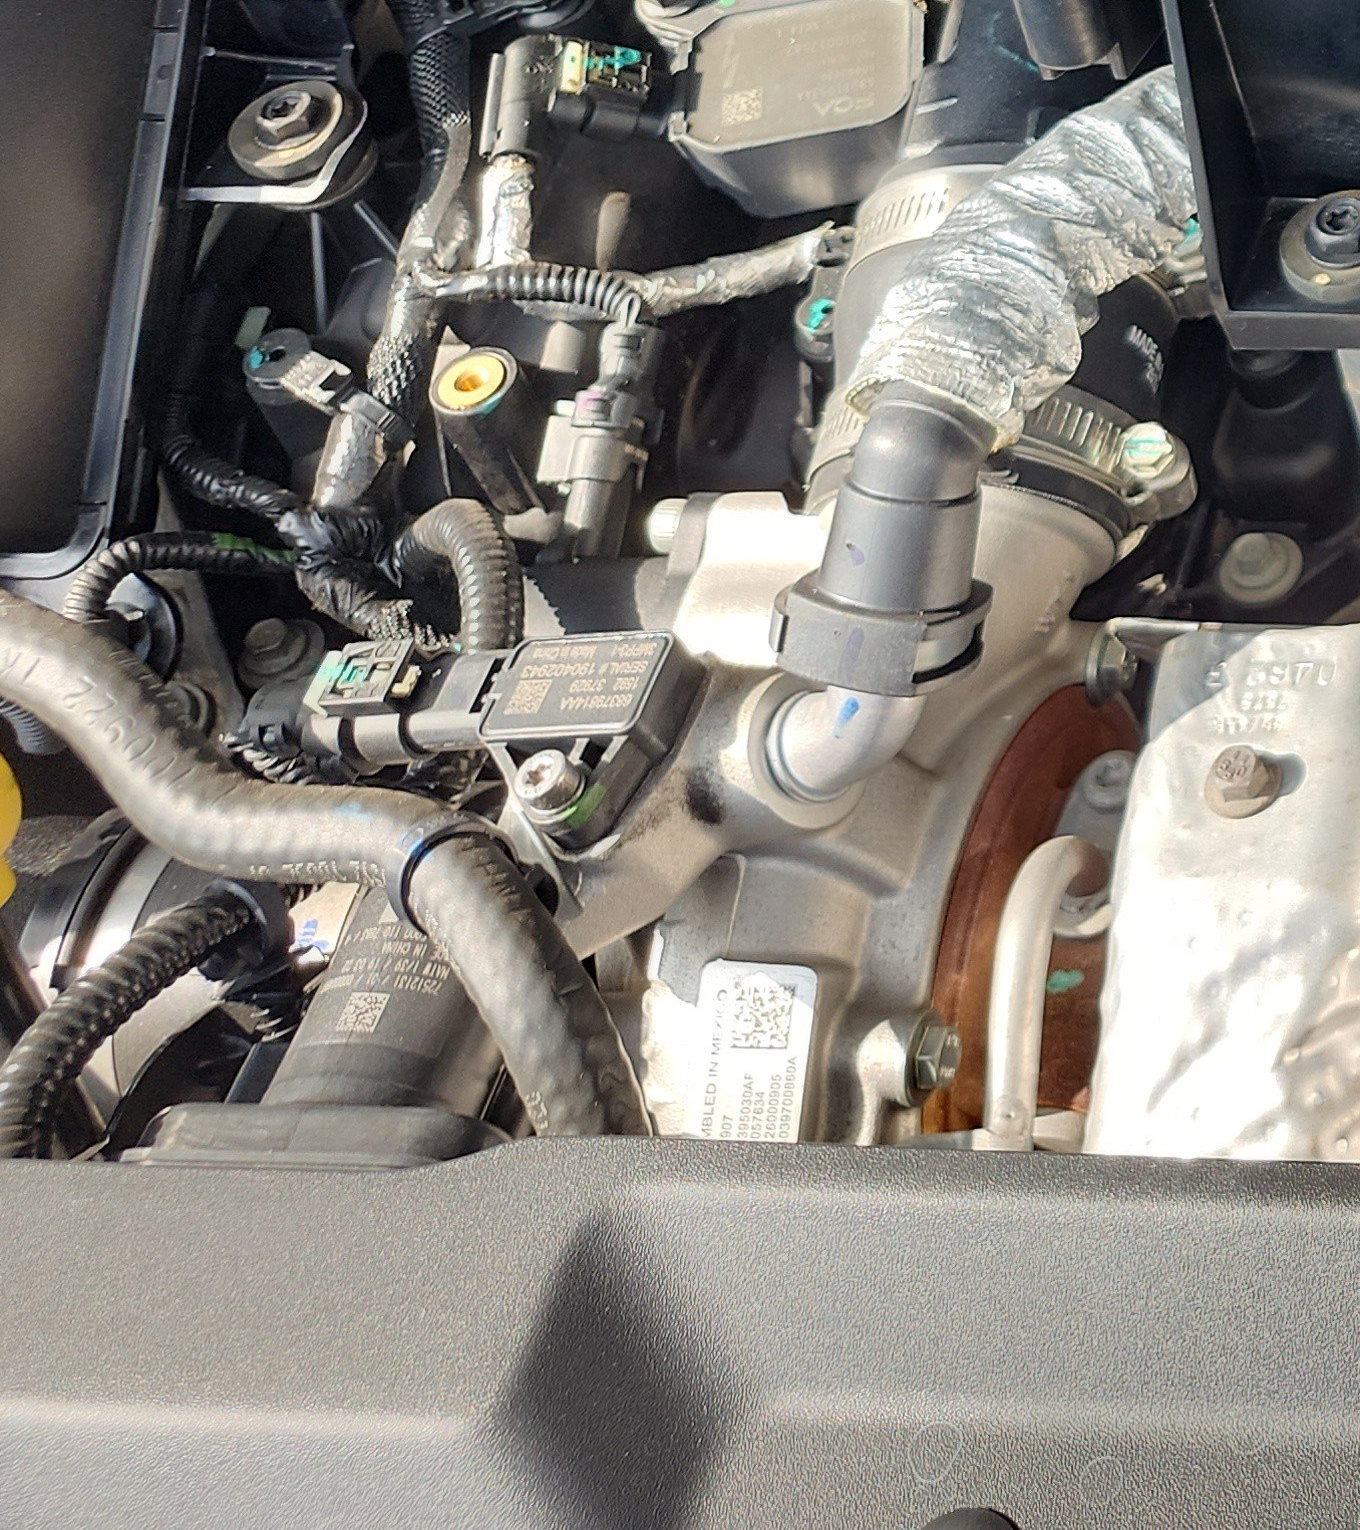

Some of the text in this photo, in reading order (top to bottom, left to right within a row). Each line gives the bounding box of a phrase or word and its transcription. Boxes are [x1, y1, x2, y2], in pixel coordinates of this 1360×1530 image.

[610, 660, 649, 675] SERIAL
[710, 989, 728, 1056] MEXICO
[708, 1061, 719, 1077] IN
